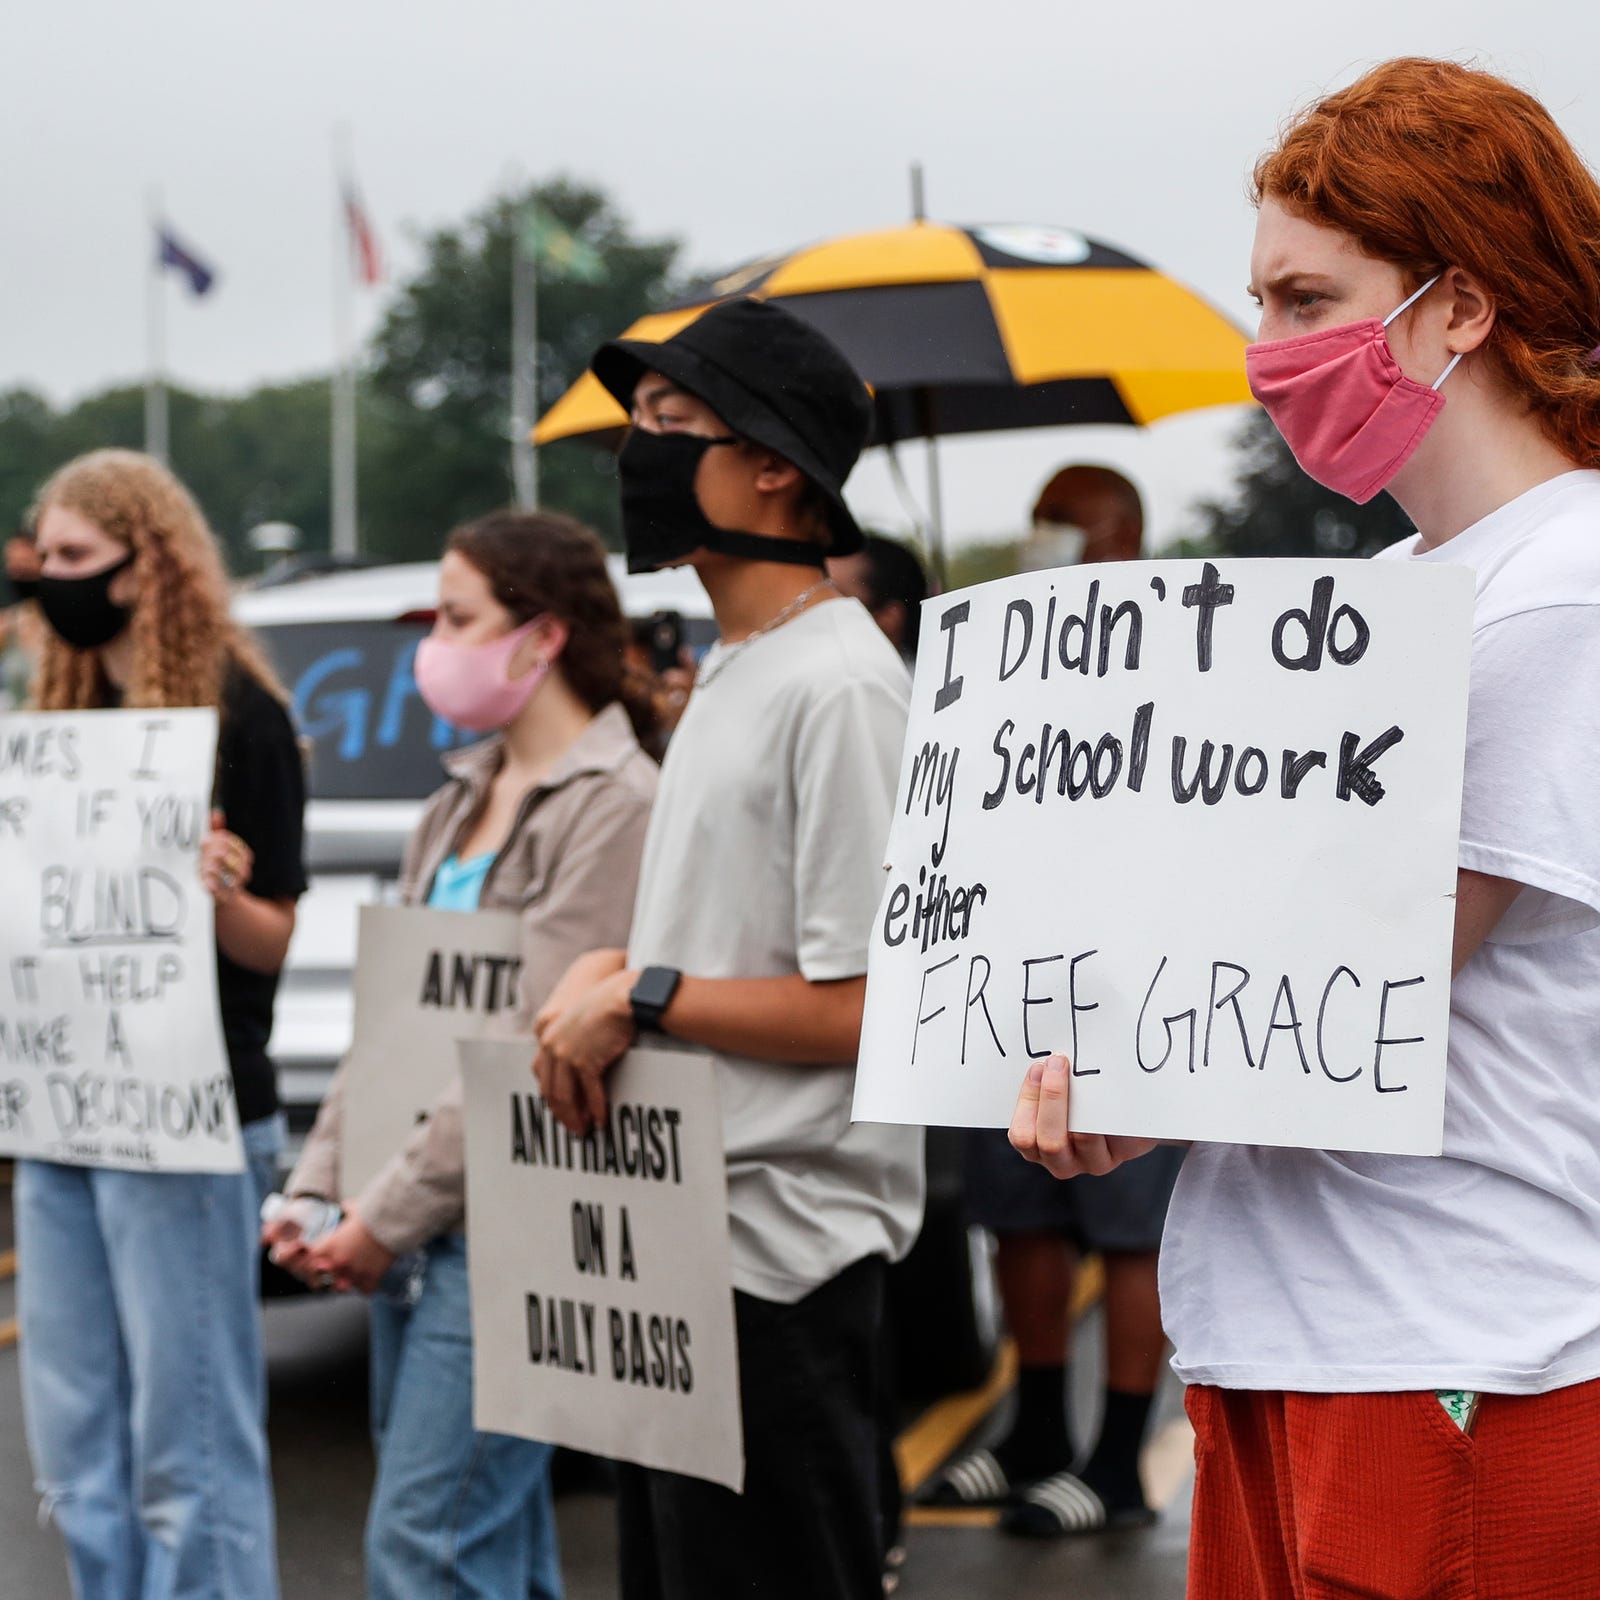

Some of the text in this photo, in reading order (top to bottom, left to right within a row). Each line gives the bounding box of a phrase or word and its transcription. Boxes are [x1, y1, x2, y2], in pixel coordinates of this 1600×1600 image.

[933, 561, 1371, 714] I Didn't do
[130, 719, 173, 781] I
[905, 701, 1405, 869] my School work
[75, 789, 118, 839] IF
[134, 793, 202, 849] YOU
[40, 866, 189, 940] BLIND
[882, 866, 988, 955] either
[79, 952, 184, 1004] HELP
[104, 1009, 134, 1068] A
[911, 950, 1425, 1094] FREE GRACE
[571, 1199, 638, 1282] ON A
[525, 1291, 694, 1395] DAILY BASIS
